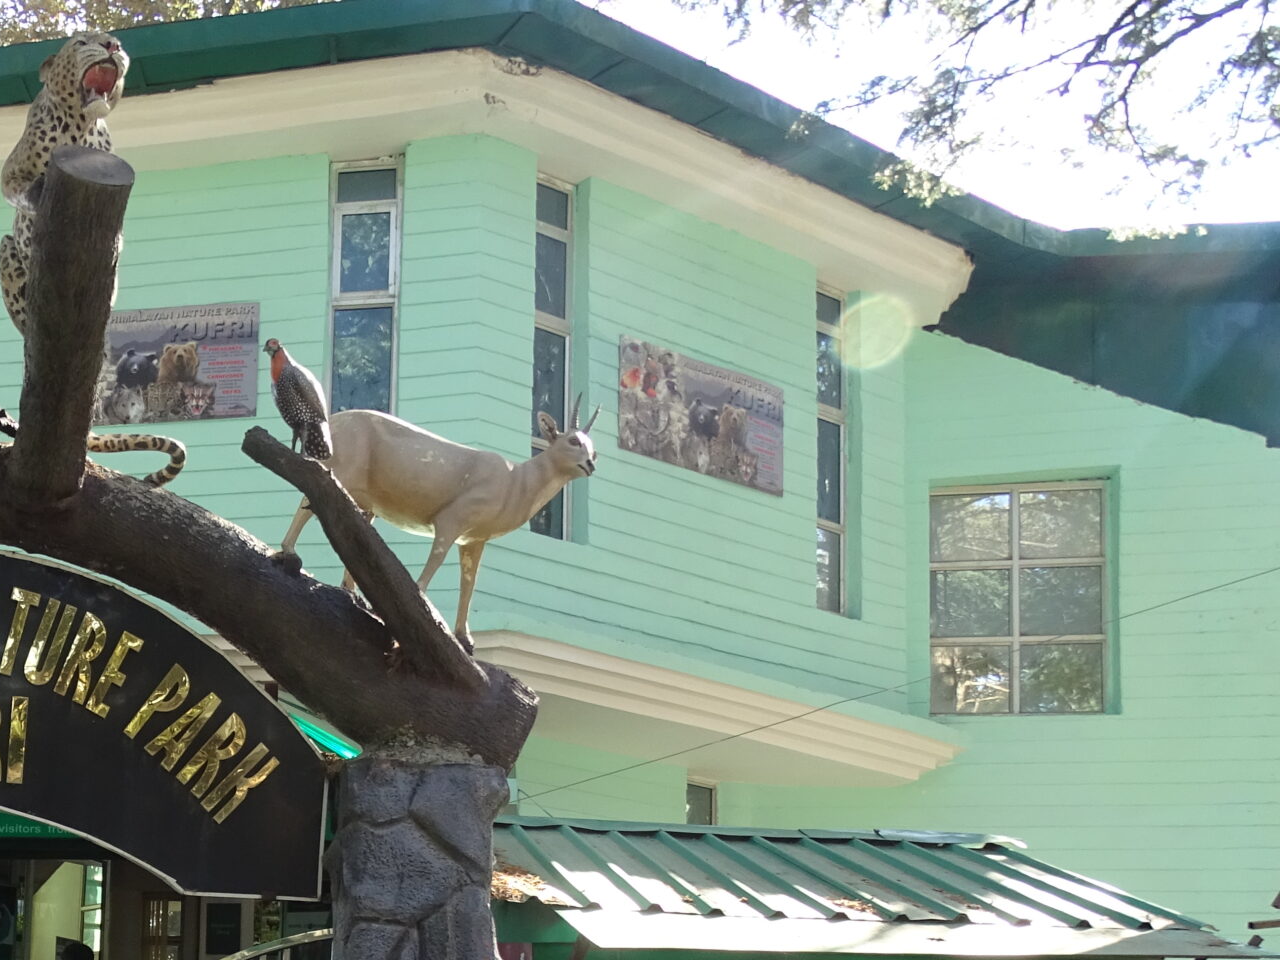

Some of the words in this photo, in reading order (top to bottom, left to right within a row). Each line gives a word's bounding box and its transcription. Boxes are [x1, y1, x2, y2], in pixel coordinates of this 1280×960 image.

[176, 308, 222, 319] NATURE
[225, 305, 255, 316] PARK
[171, 319, 253, 342] KUFRI
[123, 663, 280, 824] PARK
[47, 825, 70, 834] fro
